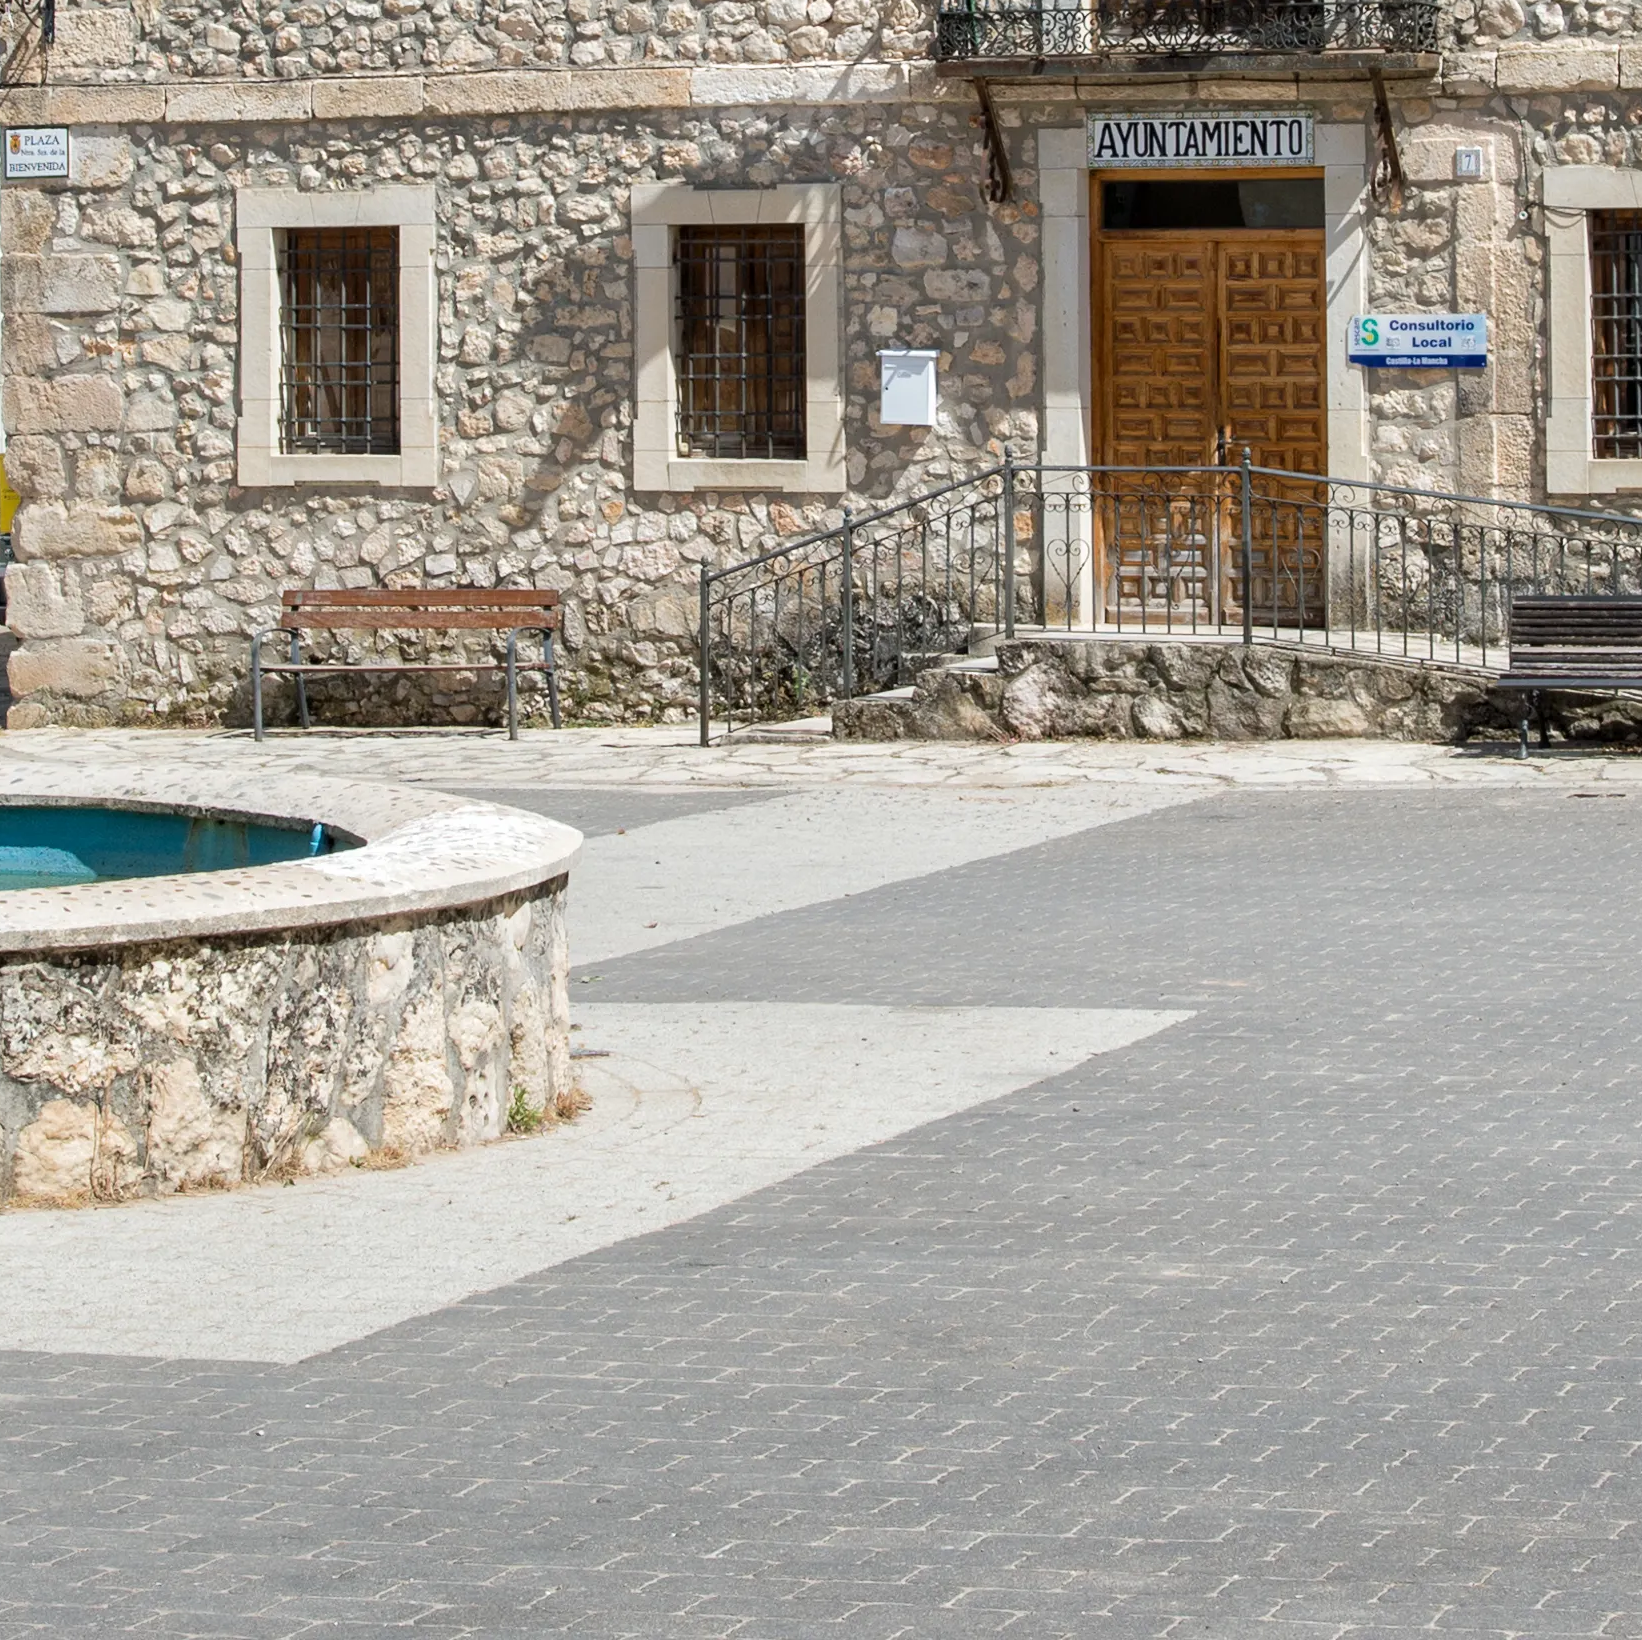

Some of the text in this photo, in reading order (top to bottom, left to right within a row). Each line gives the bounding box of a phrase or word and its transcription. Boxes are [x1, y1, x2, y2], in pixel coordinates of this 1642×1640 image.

[24, 135, 60, 146] PLAZA
[1094, 120, 1303, 158] AYUNTAMIENTO
[49, 148, 57, 156] de
[59, 148, 66, 156] la
[9, 161, 66, 172] BIENVENIDA
[1464, 154, 1472, 169] 7
[1389, 319, 1475, 331] Consultorio
[1412, 336, 1452, 348] Local
